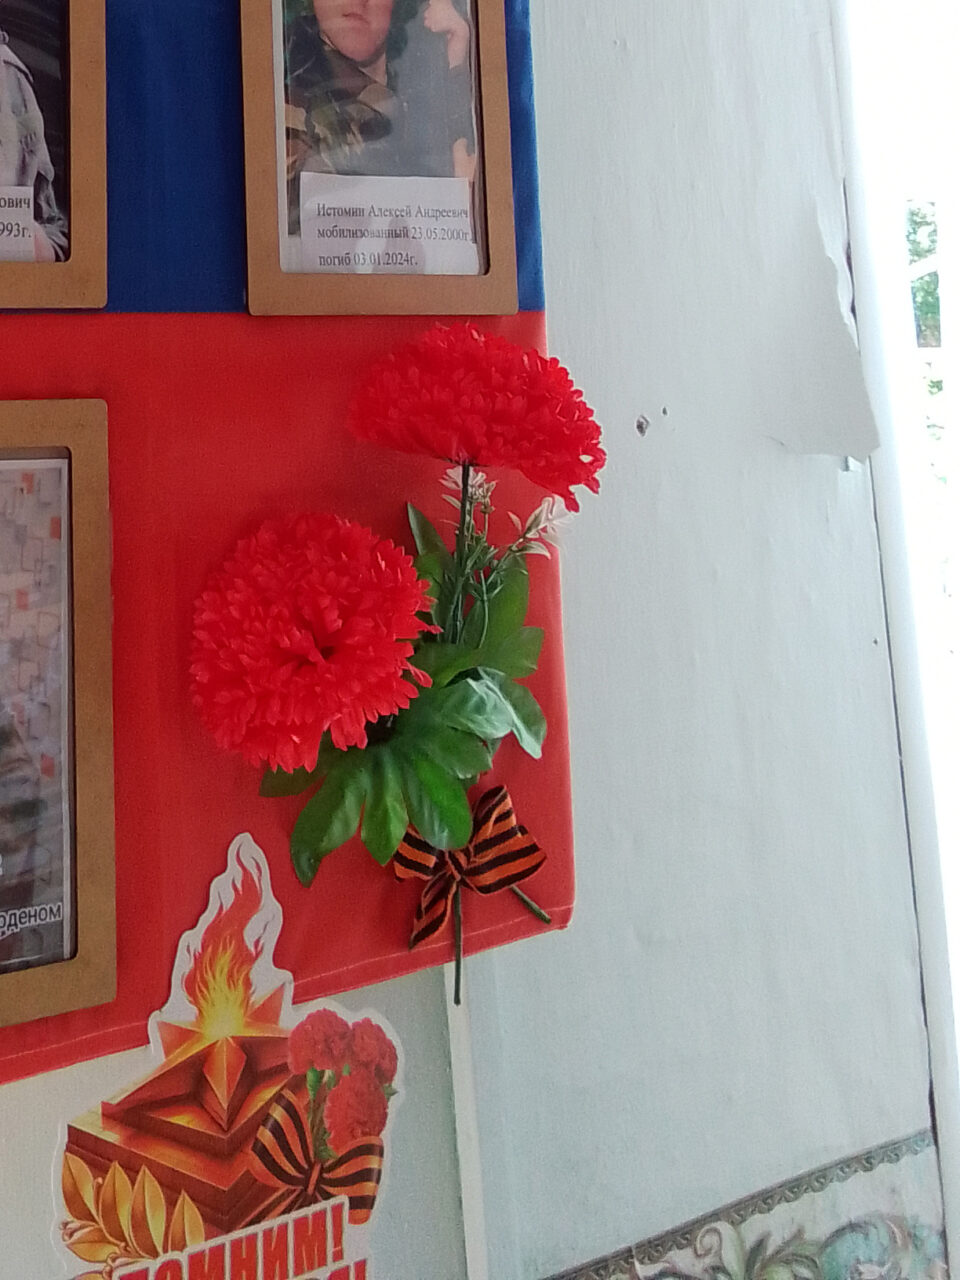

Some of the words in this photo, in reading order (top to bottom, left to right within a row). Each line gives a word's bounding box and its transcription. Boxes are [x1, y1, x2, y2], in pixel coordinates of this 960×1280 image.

[316, 203, 365, 218] Истомин
[368, 204, 411, 218] Алексей
[415, 206, 468, 220] Андреевич
[317, 225, 409, 240] мобилизованный
[319, 252, 351, 267] погиб
[120, 1202, 344, 1280] МНИМ!
